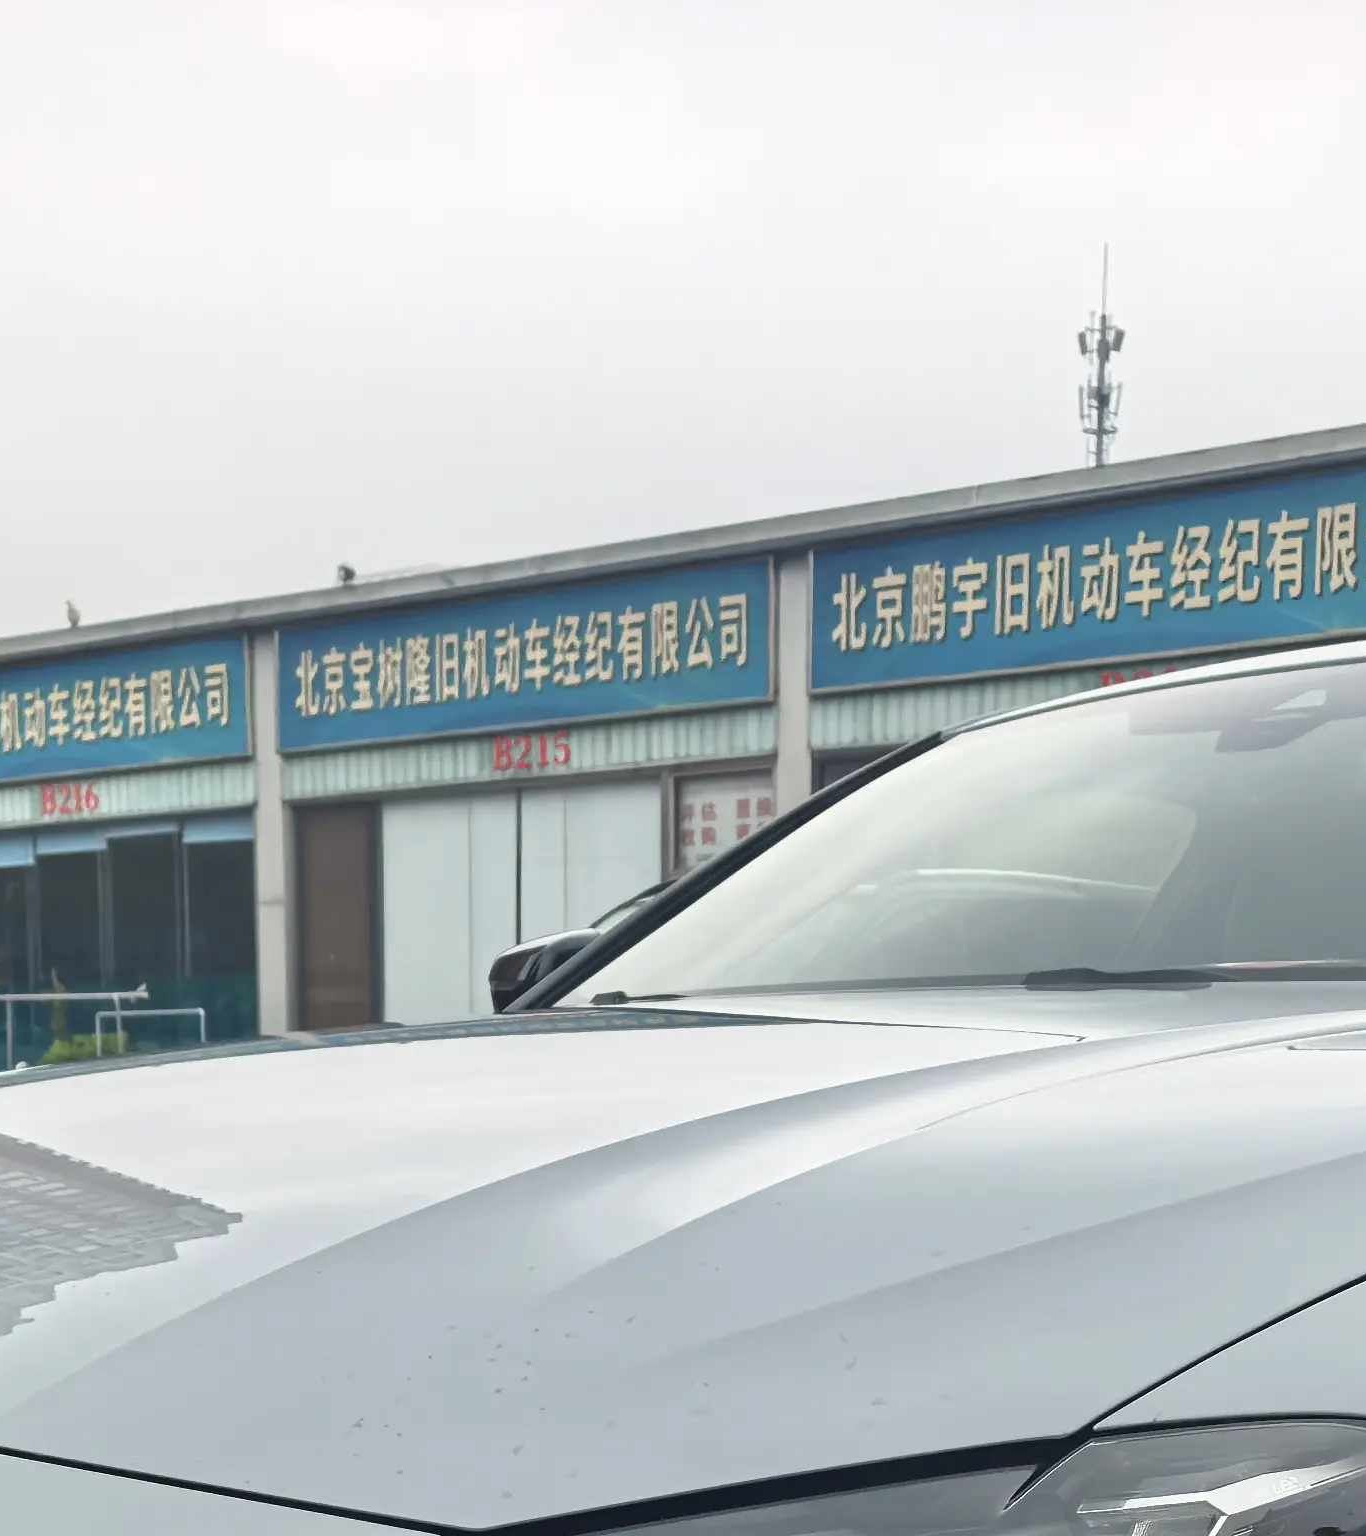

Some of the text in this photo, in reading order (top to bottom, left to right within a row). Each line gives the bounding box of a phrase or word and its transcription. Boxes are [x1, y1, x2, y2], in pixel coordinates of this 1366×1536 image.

[294, 592, 748, 717] 北京宝树隆旧机动车经纪有限公司
[493, 731, 571, 771] B215
[41, 783, 100, 815] B216
